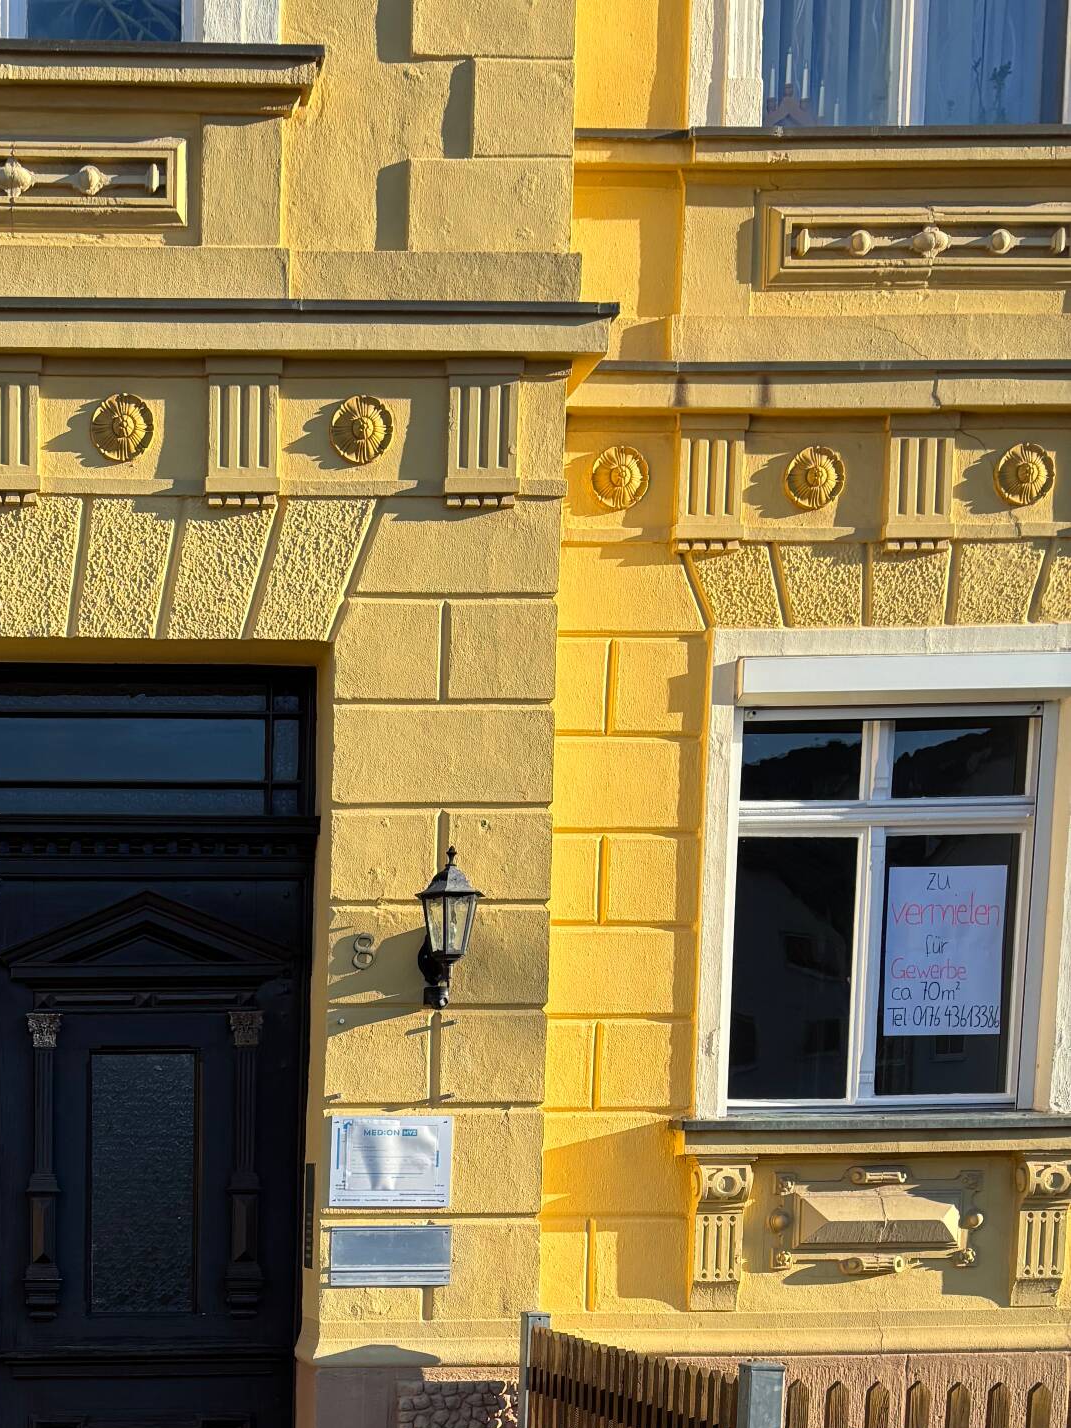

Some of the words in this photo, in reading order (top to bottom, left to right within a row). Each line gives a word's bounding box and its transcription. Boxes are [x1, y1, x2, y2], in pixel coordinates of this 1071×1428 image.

[352, 932, 374, 970] 8
[925, 935, 950, 957] für
[891, 957, 967, 981] Gewerbe
[891, 987, 913, 1001] ca
[912, 1005, 941, 1028] 0176
